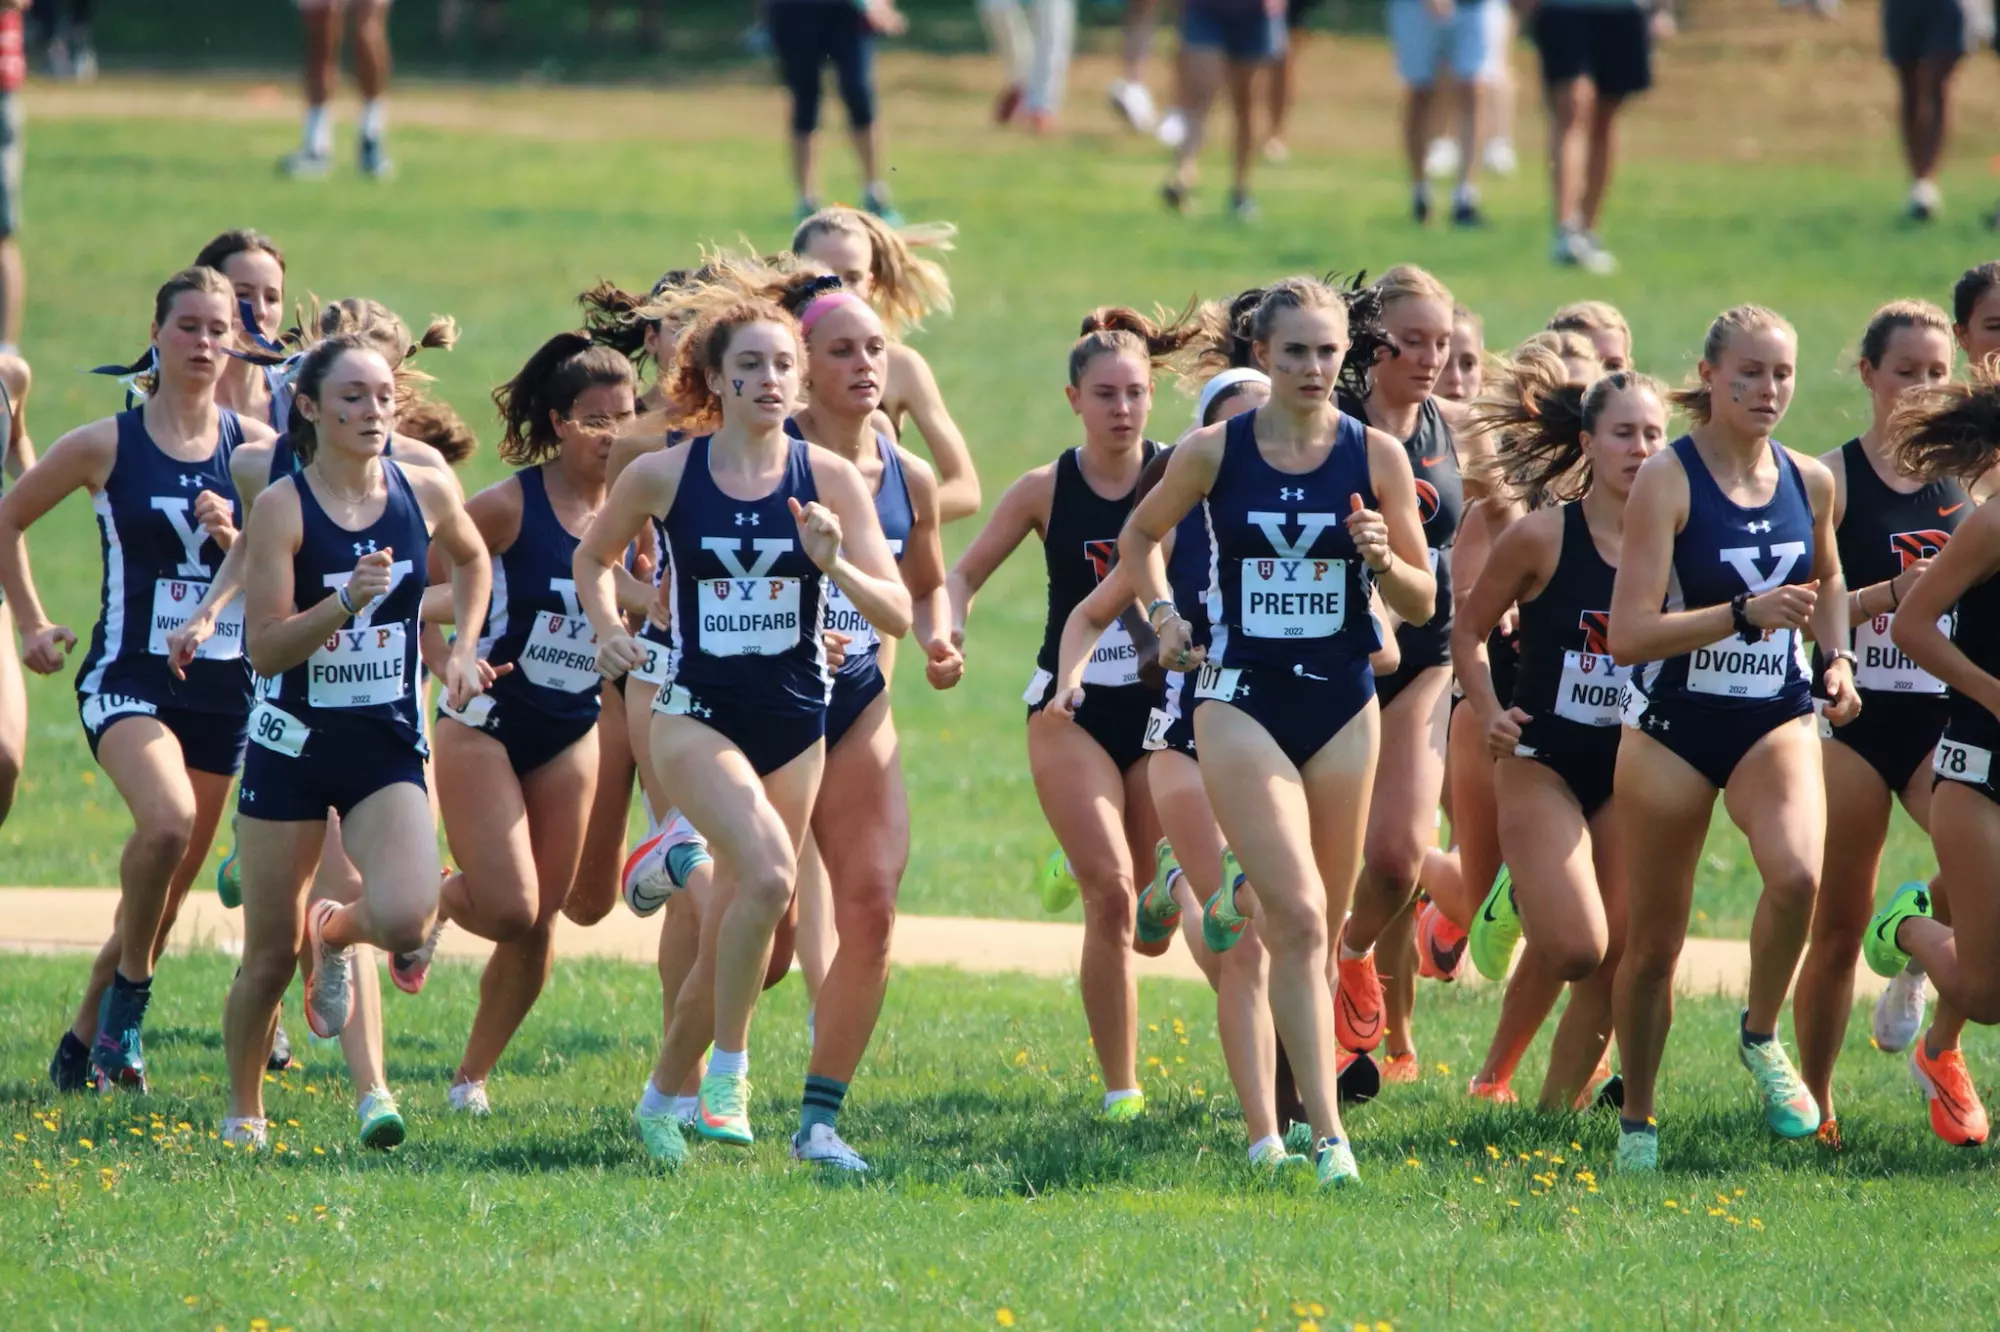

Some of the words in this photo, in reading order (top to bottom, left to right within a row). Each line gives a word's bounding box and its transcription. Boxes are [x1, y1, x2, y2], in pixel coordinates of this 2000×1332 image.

[1281, 561, 1300, 581] Y
[1313, 561, 1329, 581] P
[736, 581, 757, 600] Y
[769, 581, 784, 600] P
[1250, 592, 1339, 615] PRETRE
[567, 620, 587, 639] Y
[704, 611, 797, 632] GOLDFARB
[1284, 627, 1304, 636] 2022
[346, 631, 366, 651] Y
[376, 628, 391, 648] P
[526, 643, 599, 673] KARPERO
[742, 646, 761, 655] 2022
[1866, 646, 1919, 670] BUR
[313, 657, 402, 684] FONVILLE
[1695, 648, 1785, 675] DVORAK
[1123, 673, 1138, 682] 202
[1895, 681, 1913, 690] 2022
[351, 694, 371, 704] 2022
[1571, 683, 1621, 707] NOB
[1729, 685, 1748, 695] 2022
[257, 711, 287, 742] 96
[1940, 744, 1967, 773] 78
